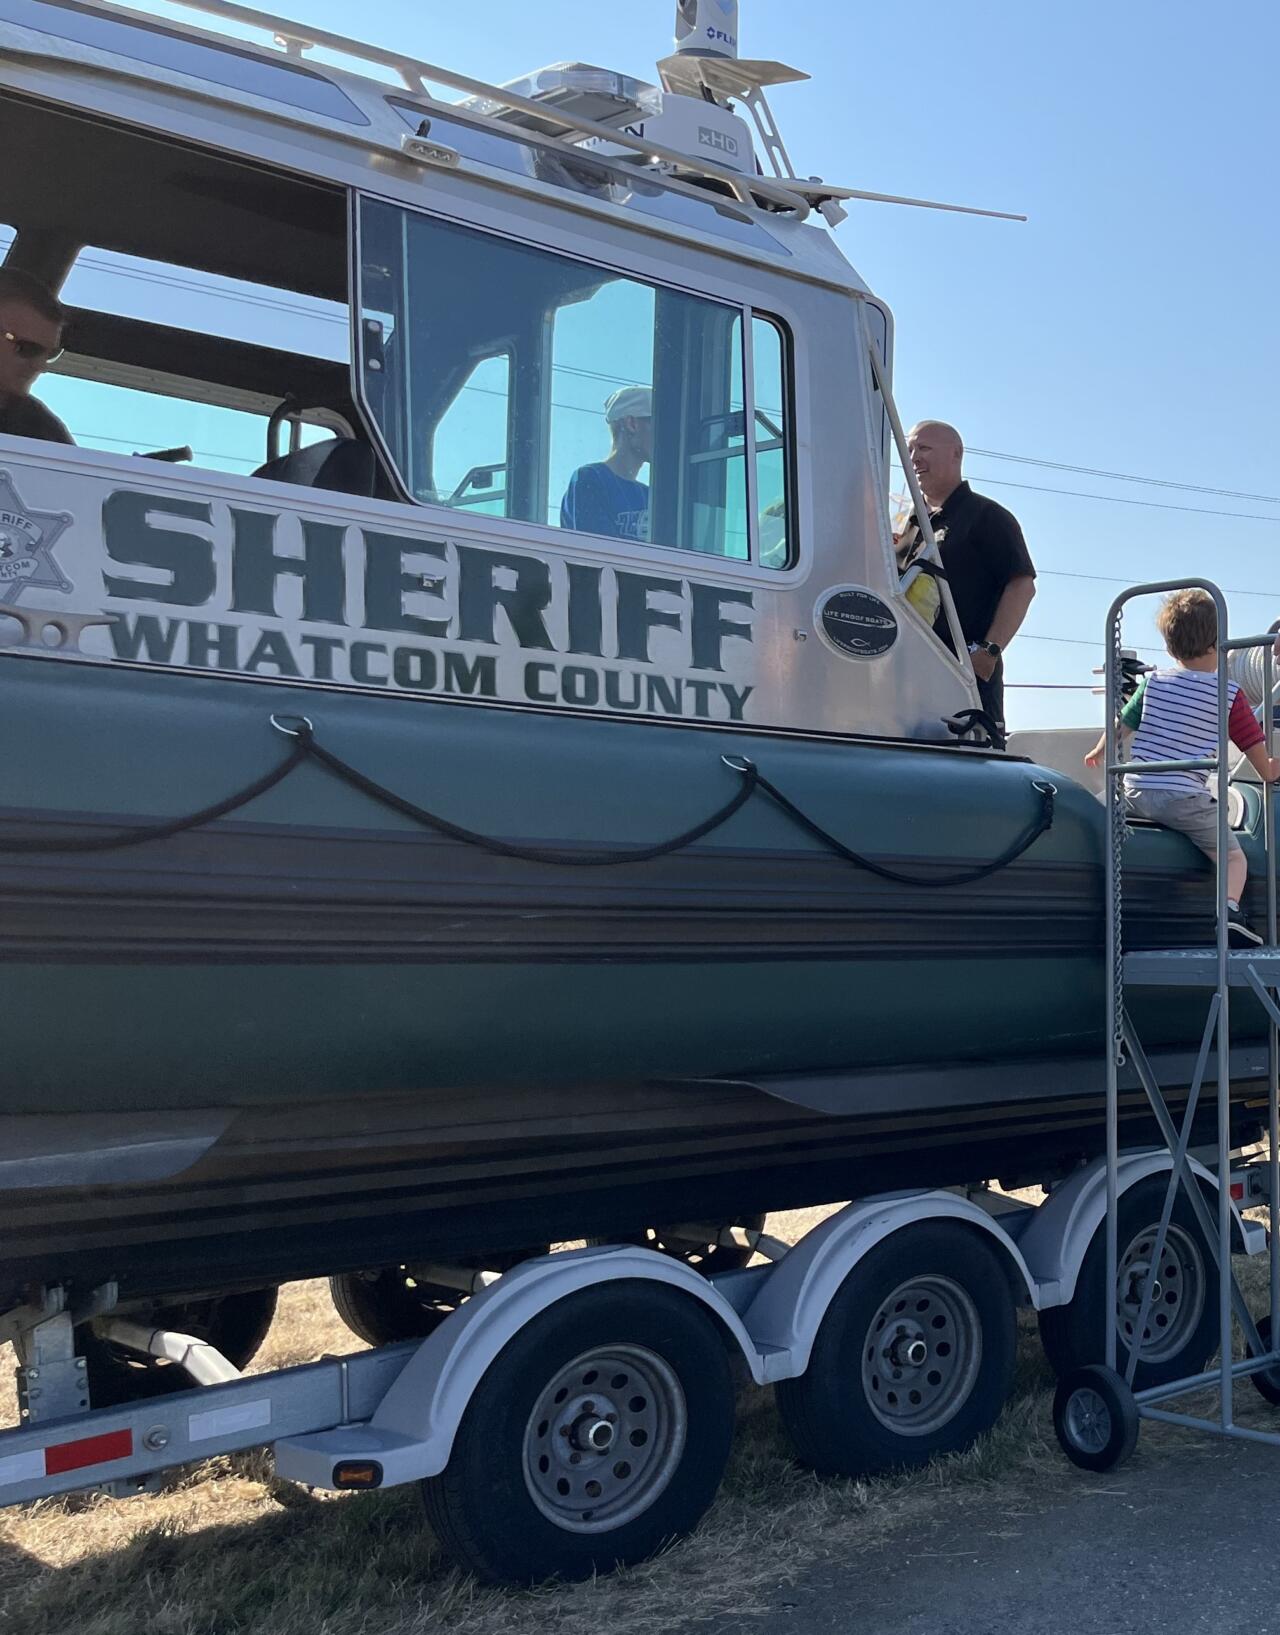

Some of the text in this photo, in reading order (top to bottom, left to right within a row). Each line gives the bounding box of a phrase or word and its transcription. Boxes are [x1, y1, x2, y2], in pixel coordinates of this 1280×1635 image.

[701, 134, 738, 152] xHD
[2, 513, 33, 530] RIFF
[100, 489, 757, 673] SHERIFF
[823, 609, 888, 625] LIFE PROOF BOATS
[100, 607, 755, 721] WHATCOM COUNTY
